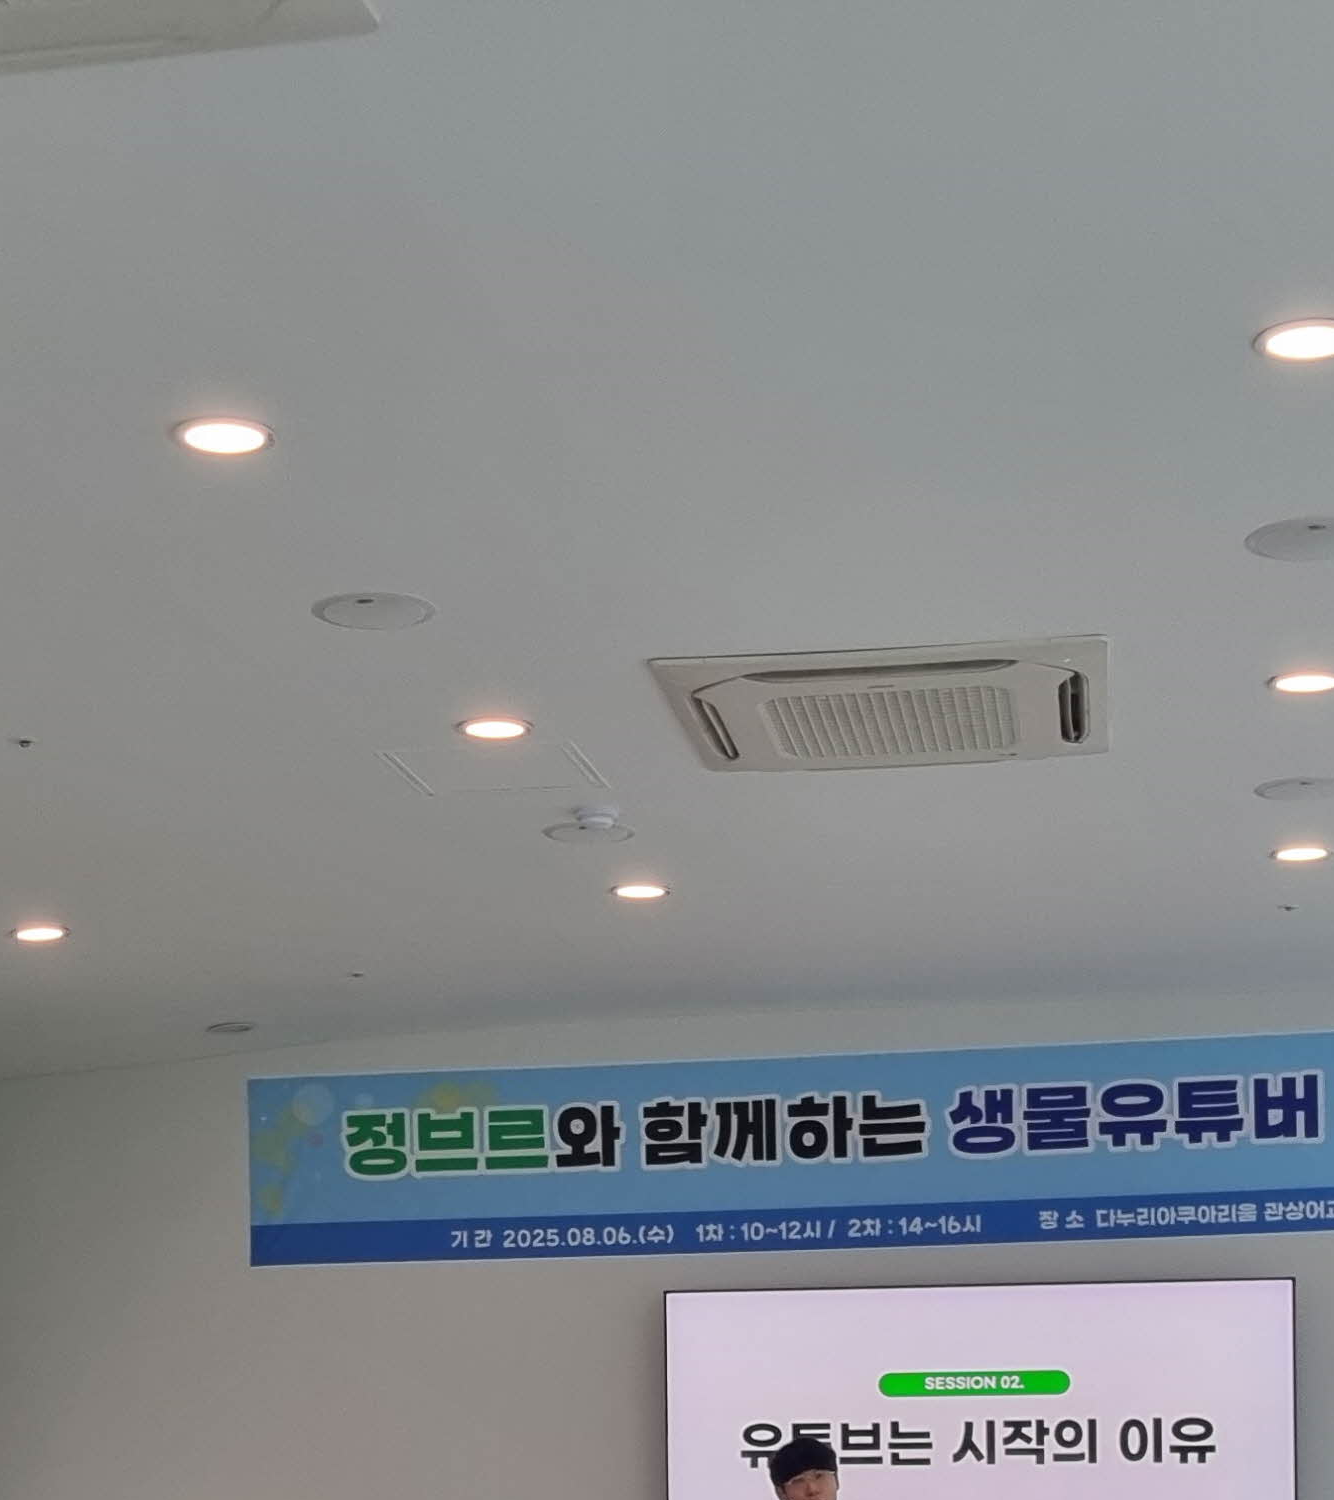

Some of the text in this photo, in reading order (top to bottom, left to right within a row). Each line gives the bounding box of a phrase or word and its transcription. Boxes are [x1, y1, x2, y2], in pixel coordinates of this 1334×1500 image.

[345, 1103, 622, 1176] 정브르와
[641, 1094, 927, 1167] 함께하는
[948, 1073, 1320, 1155] 생물유튜버
[502, 1224, 674, 1248] 2025.08.06.(수)
[1094, 1202, 1258, 1228] 다누리아쿠아리움
[924, 1375, 1025, 1390] SESSION 02.
[952, 1418, 1098, 1465] 시작의
[1119, 1416, 1217, 1464] 이유
